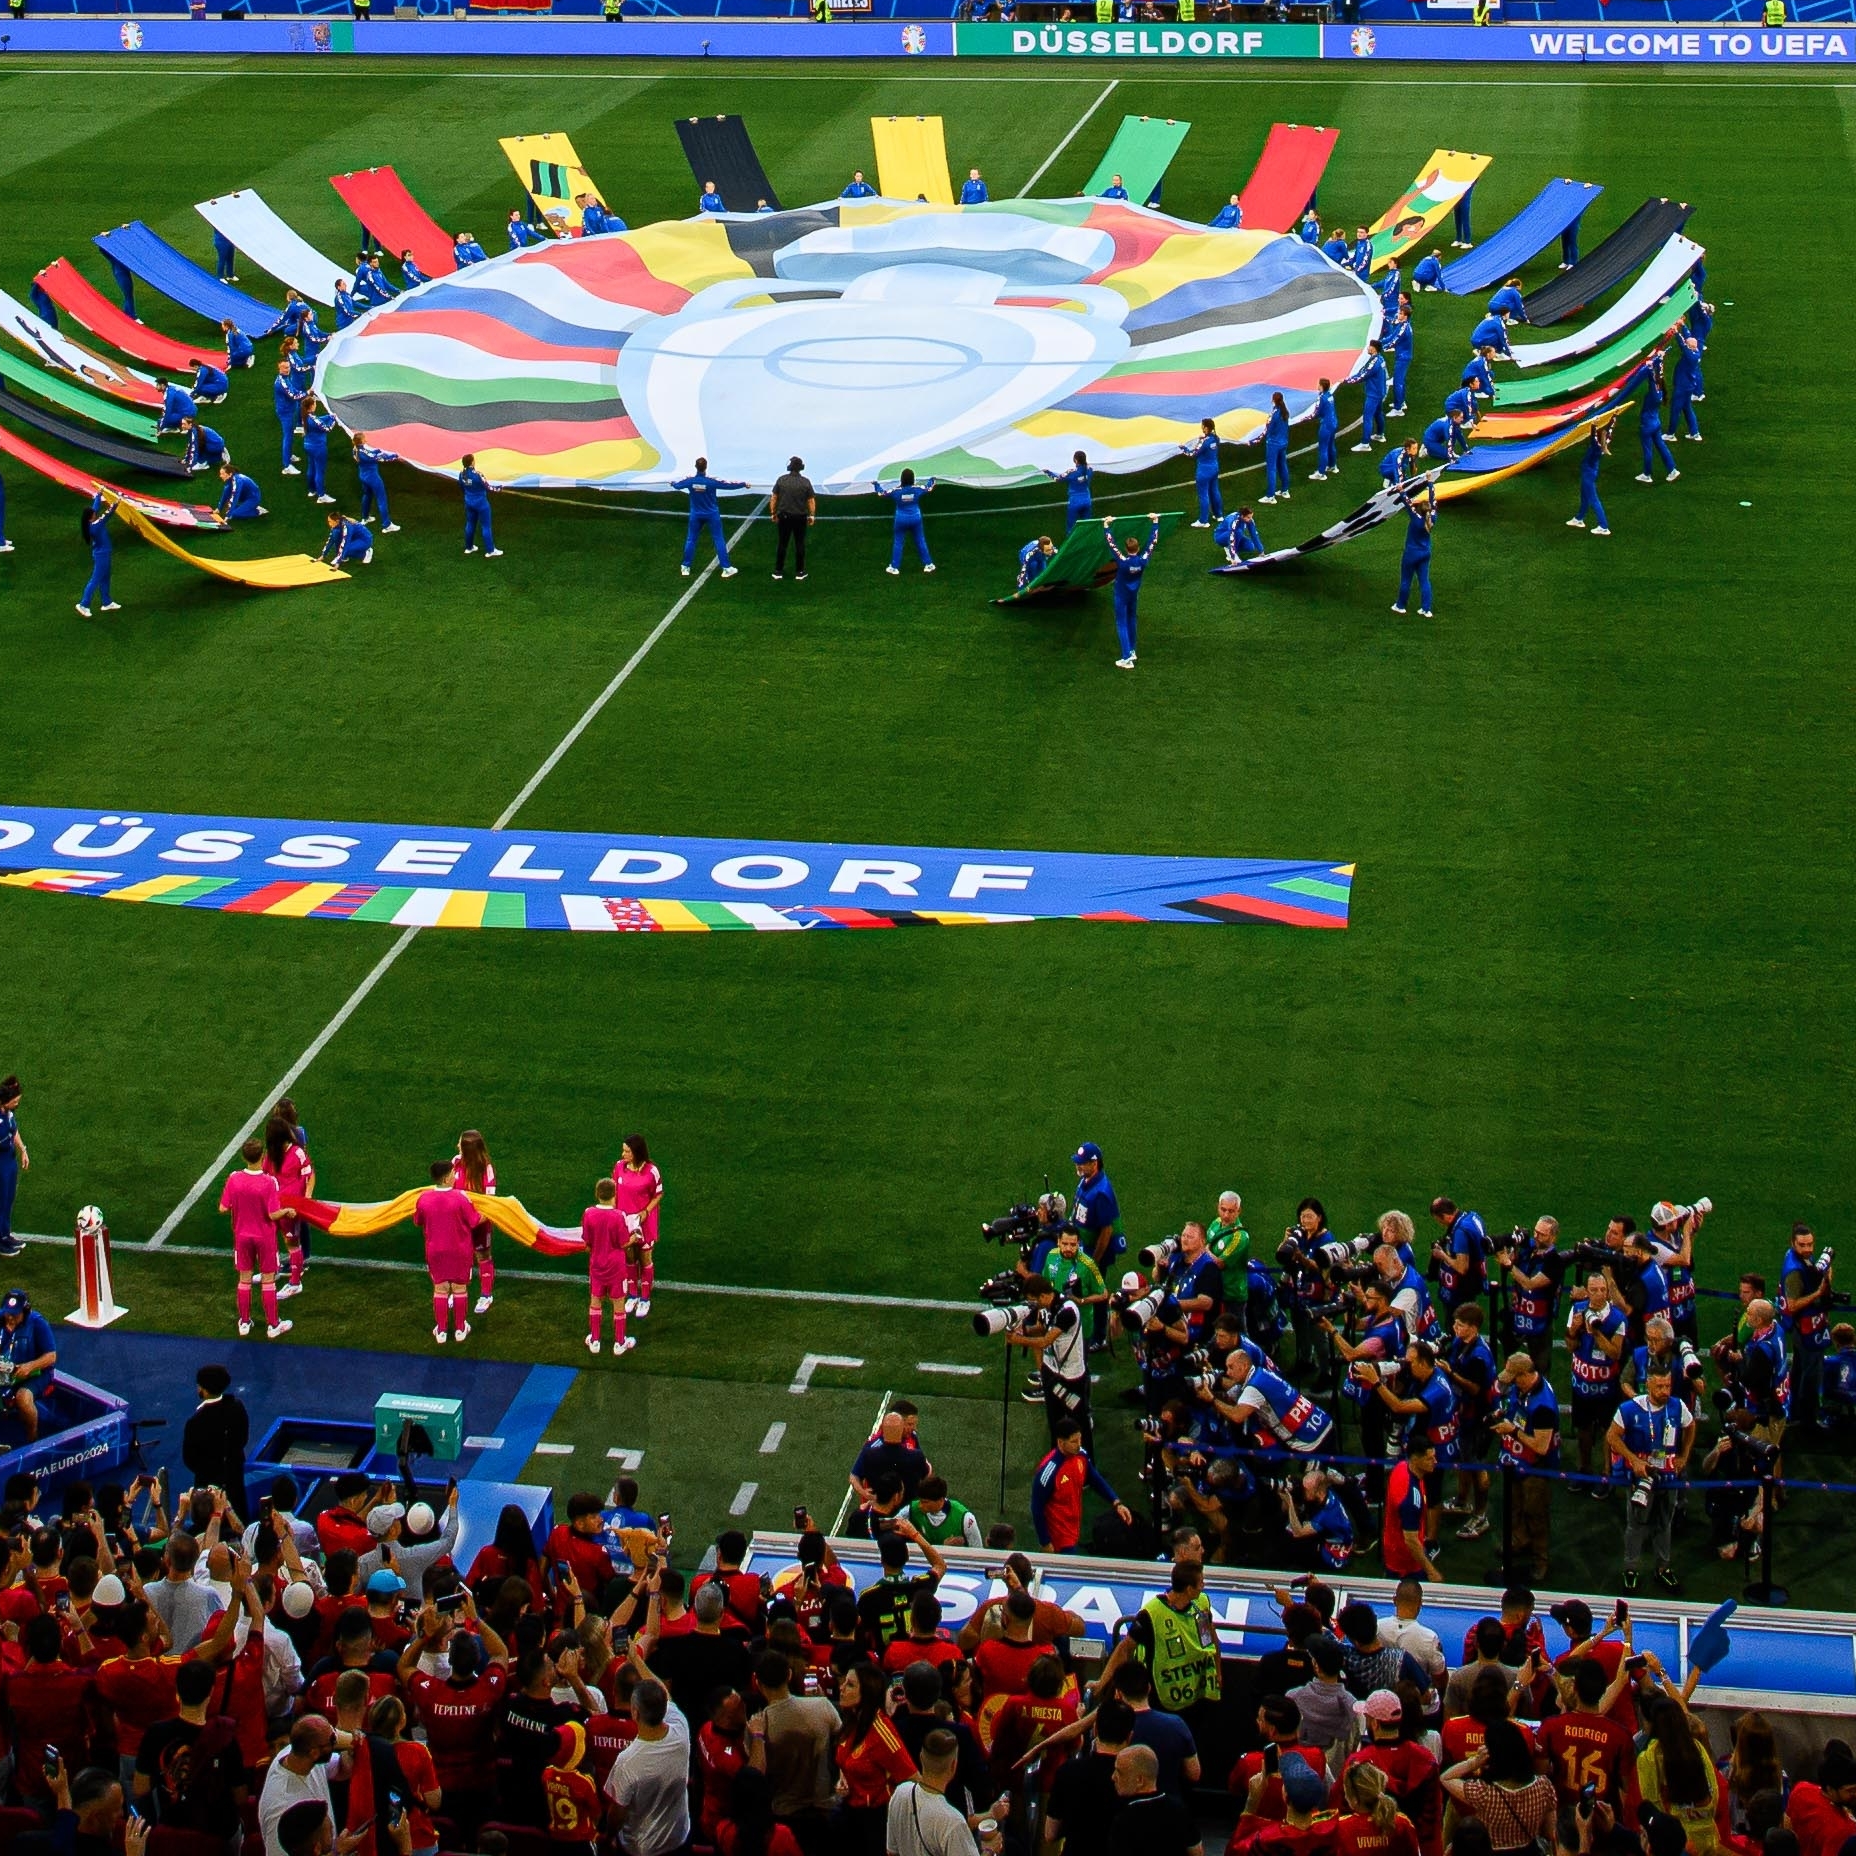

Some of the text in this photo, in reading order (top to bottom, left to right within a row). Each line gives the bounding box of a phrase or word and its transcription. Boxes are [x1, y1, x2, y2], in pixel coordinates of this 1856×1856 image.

[1012, 24, 1263, 55] DÜSSELDORF
[1529, 33, 1701, 56] WELCOME
[1708, 33, 1753, 56] TO
[1760, 34, 1846, 56] UEFA
[29, 1442, 110, 1481] FAEURO2024
[593, 1734, 633, 1751] TEPELEN
[1564, 1724, 1608, 1744] RODRIGO
[1561, 1744, 1608, 1794] 16
[546, 1792, 579, 1831] 19
